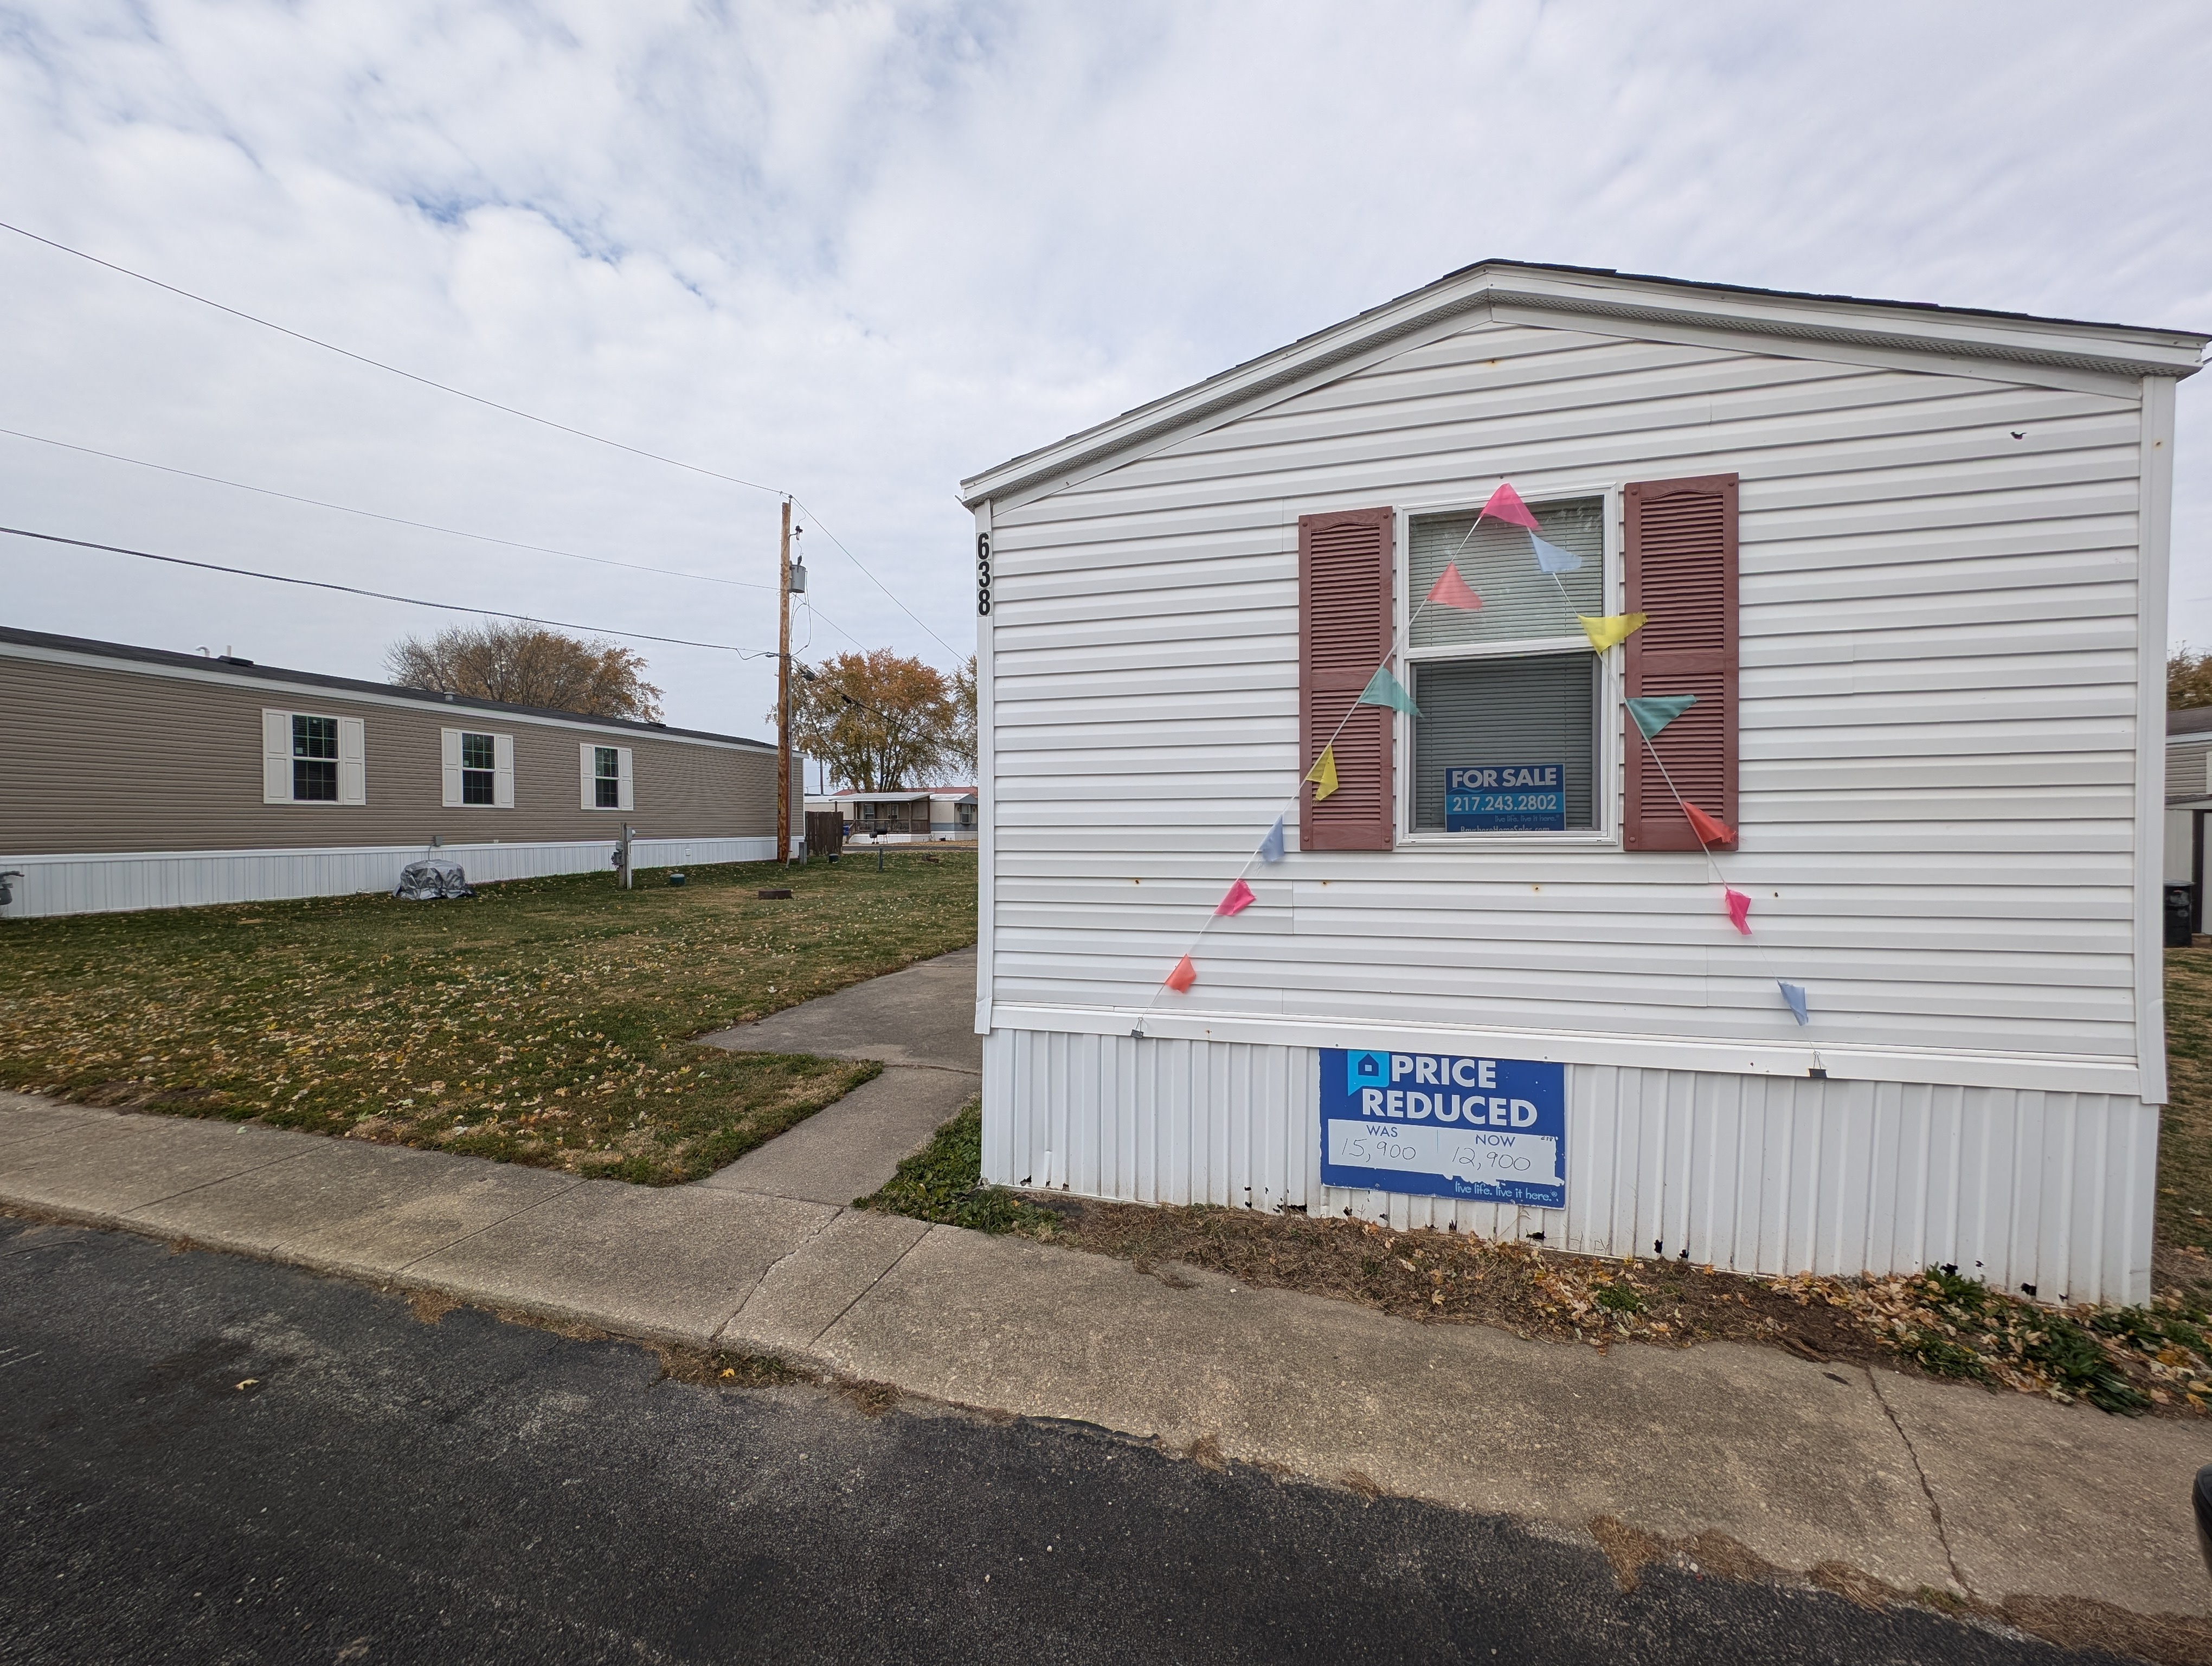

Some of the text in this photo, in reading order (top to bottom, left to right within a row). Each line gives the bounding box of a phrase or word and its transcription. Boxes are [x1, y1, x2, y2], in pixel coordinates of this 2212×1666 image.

[978, 533, 991, 616] 638
[1452, 768, 1557, 787] FOR SALE
[1453, 794, 1557, 811] 217.243.2802
[1392, 1055, 1496, 1088] PRICE
[1362, 1088, 1538, 1127] REDUCED
[1366, 1125, 1398, 1138] WAS
[1475, 1134, 1516, 1147] NOW
[1341, 1138, 1417, 1163] 15,900
[1452, 1146, 1531, 1171] 12,900
[1455, 1181, 1471, 1193] live
[1474, 1183, 1492, 1195] life.
[1495, 1186, 1512, 1197] live
[1515, 1188, 1522, 1198] it
